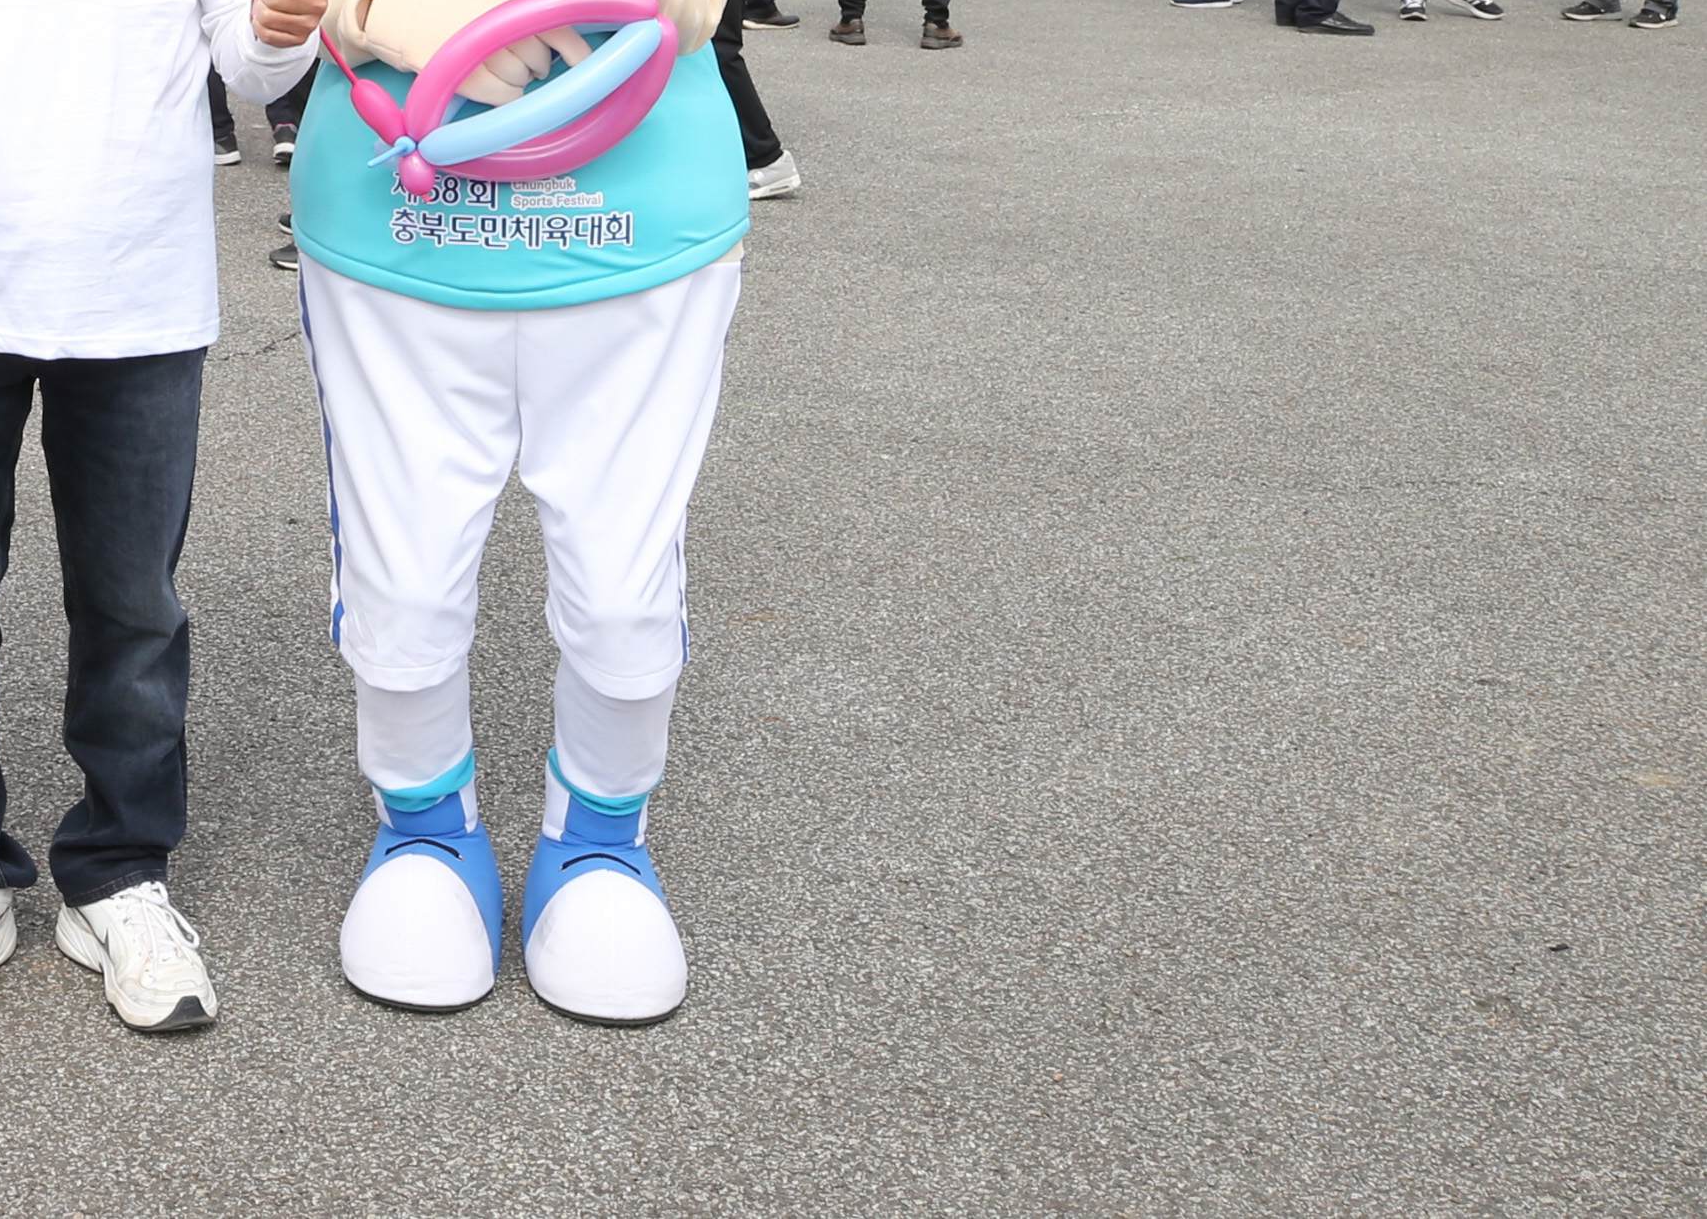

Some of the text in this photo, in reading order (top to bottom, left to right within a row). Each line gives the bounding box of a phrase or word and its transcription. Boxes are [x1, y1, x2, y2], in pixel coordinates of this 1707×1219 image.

[512, 178, 576, 193] Chungbuk
[512, 191, 602, 208] Sports Festival
[391, 209, 633, 249] 충북도민체육대회
